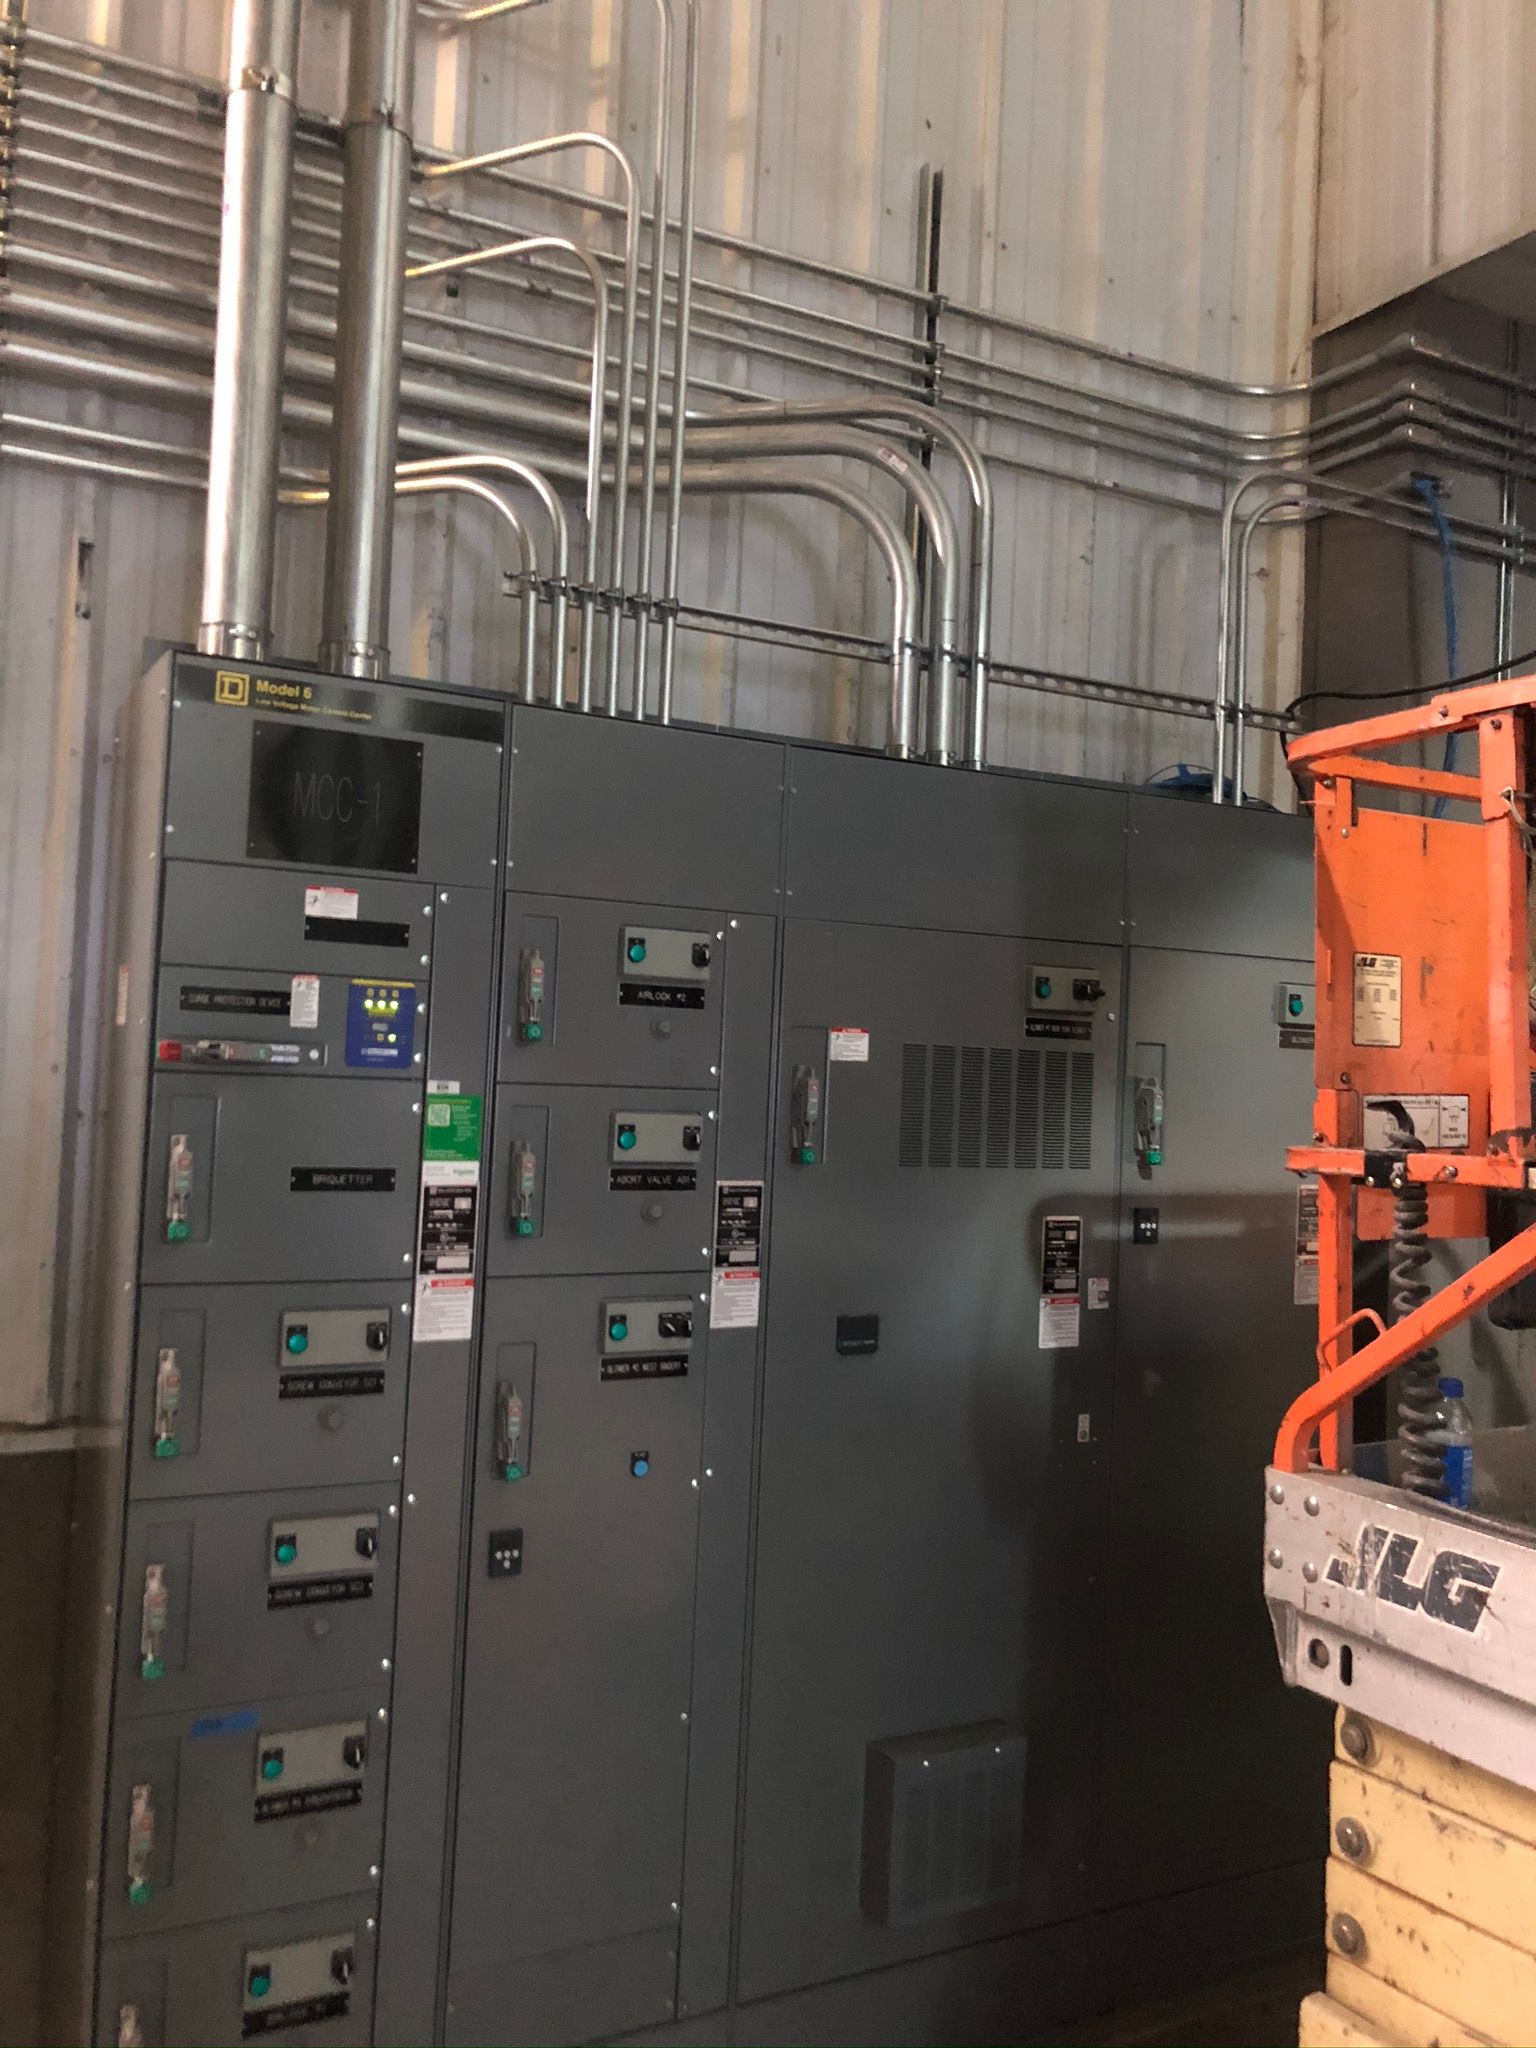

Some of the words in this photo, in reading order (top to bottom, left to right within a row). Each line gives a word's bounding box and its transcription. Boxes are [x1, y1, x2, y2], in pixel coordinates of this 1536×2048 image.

[256, 679, 299, 697] Model
[303, 687, 313, 699] 6
[294, 771, 381, 825] MCC-1
[638, 991, 672, 1001] AIRLOCK
[616, 1174, 642, 1185] ABORT
[646, 1175, 673, 1185] VALVE
[1324, 1520, 1501, 1634] JLG
